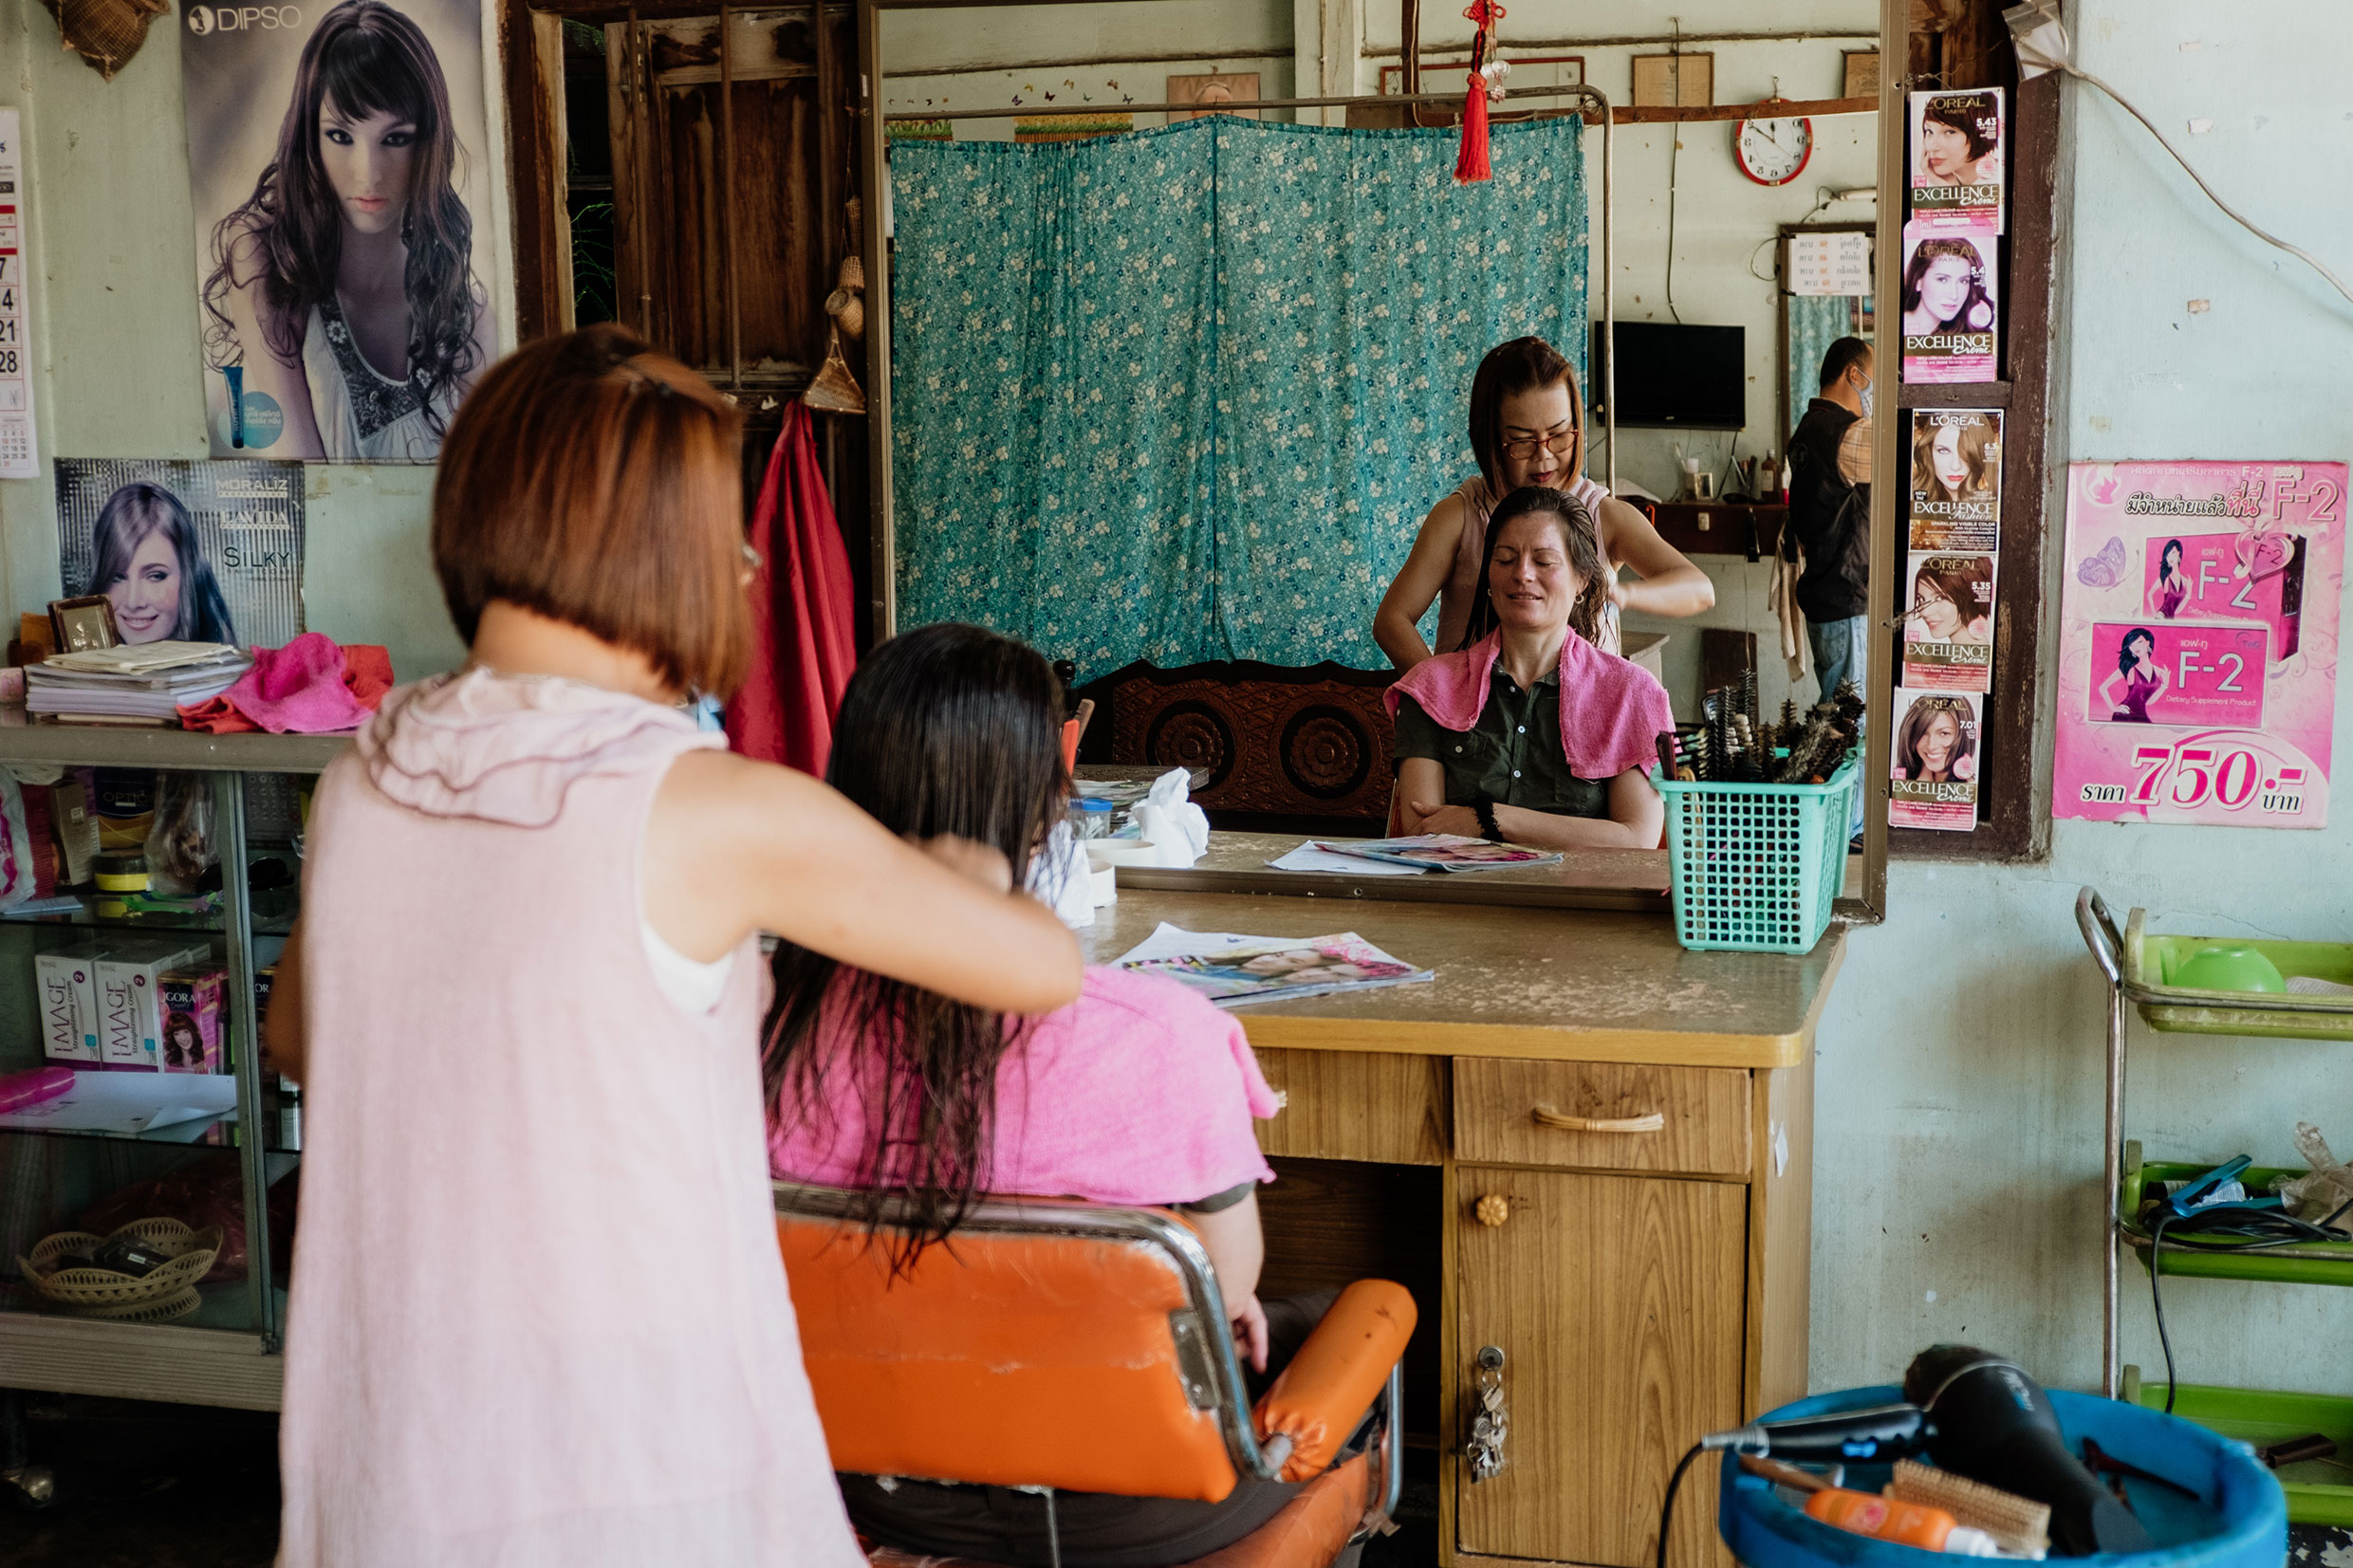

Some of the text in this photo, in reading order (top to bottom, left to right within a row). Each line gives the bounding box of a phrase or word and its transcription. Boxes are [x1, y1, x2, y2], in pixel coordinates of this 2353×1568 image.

[217, 5, 302, 30] DIPSO
[1976, 118, 1997, 127] 5.43
[1914, 185, 1998, 201] EXCELLENCE
[1906, 334, 1991, 349] EXCELLENCE
[2242, 466, 2264, 477] F-2
[1914, 501, 1994, 514] EXCELLENCE
[2271, 477, 2340, 522] F-2
[219, 507, 289, 525] LAVIDA
[1948, 509, 1993, 520] Fashion
[2255, 544, 2283, 564] F-2
[1972, 581, 1992, 590] 5.35
[2197, 560, 2257, 610] F-2
[1906, 643, 1990, 657] EXCELLENCE
[2177, 651, 2244, 692] F-2
[2165, 695, 2256, 707] Dietary Supplement Product
[1893, 781, 1974, 797] EXCELLENCE
[2083, 784, 2125, 802] ราคา
[2262, 794, 2300, 811] บาท
[161, 991, 196, 1004] IGORA
[46, 976, 73, 1053] IMAGE
[106, 980, 132, 1057] IMAGE
[70, 1004, 79, 1050] Straightening
[129, 1007, 138, 1054] Straightening
